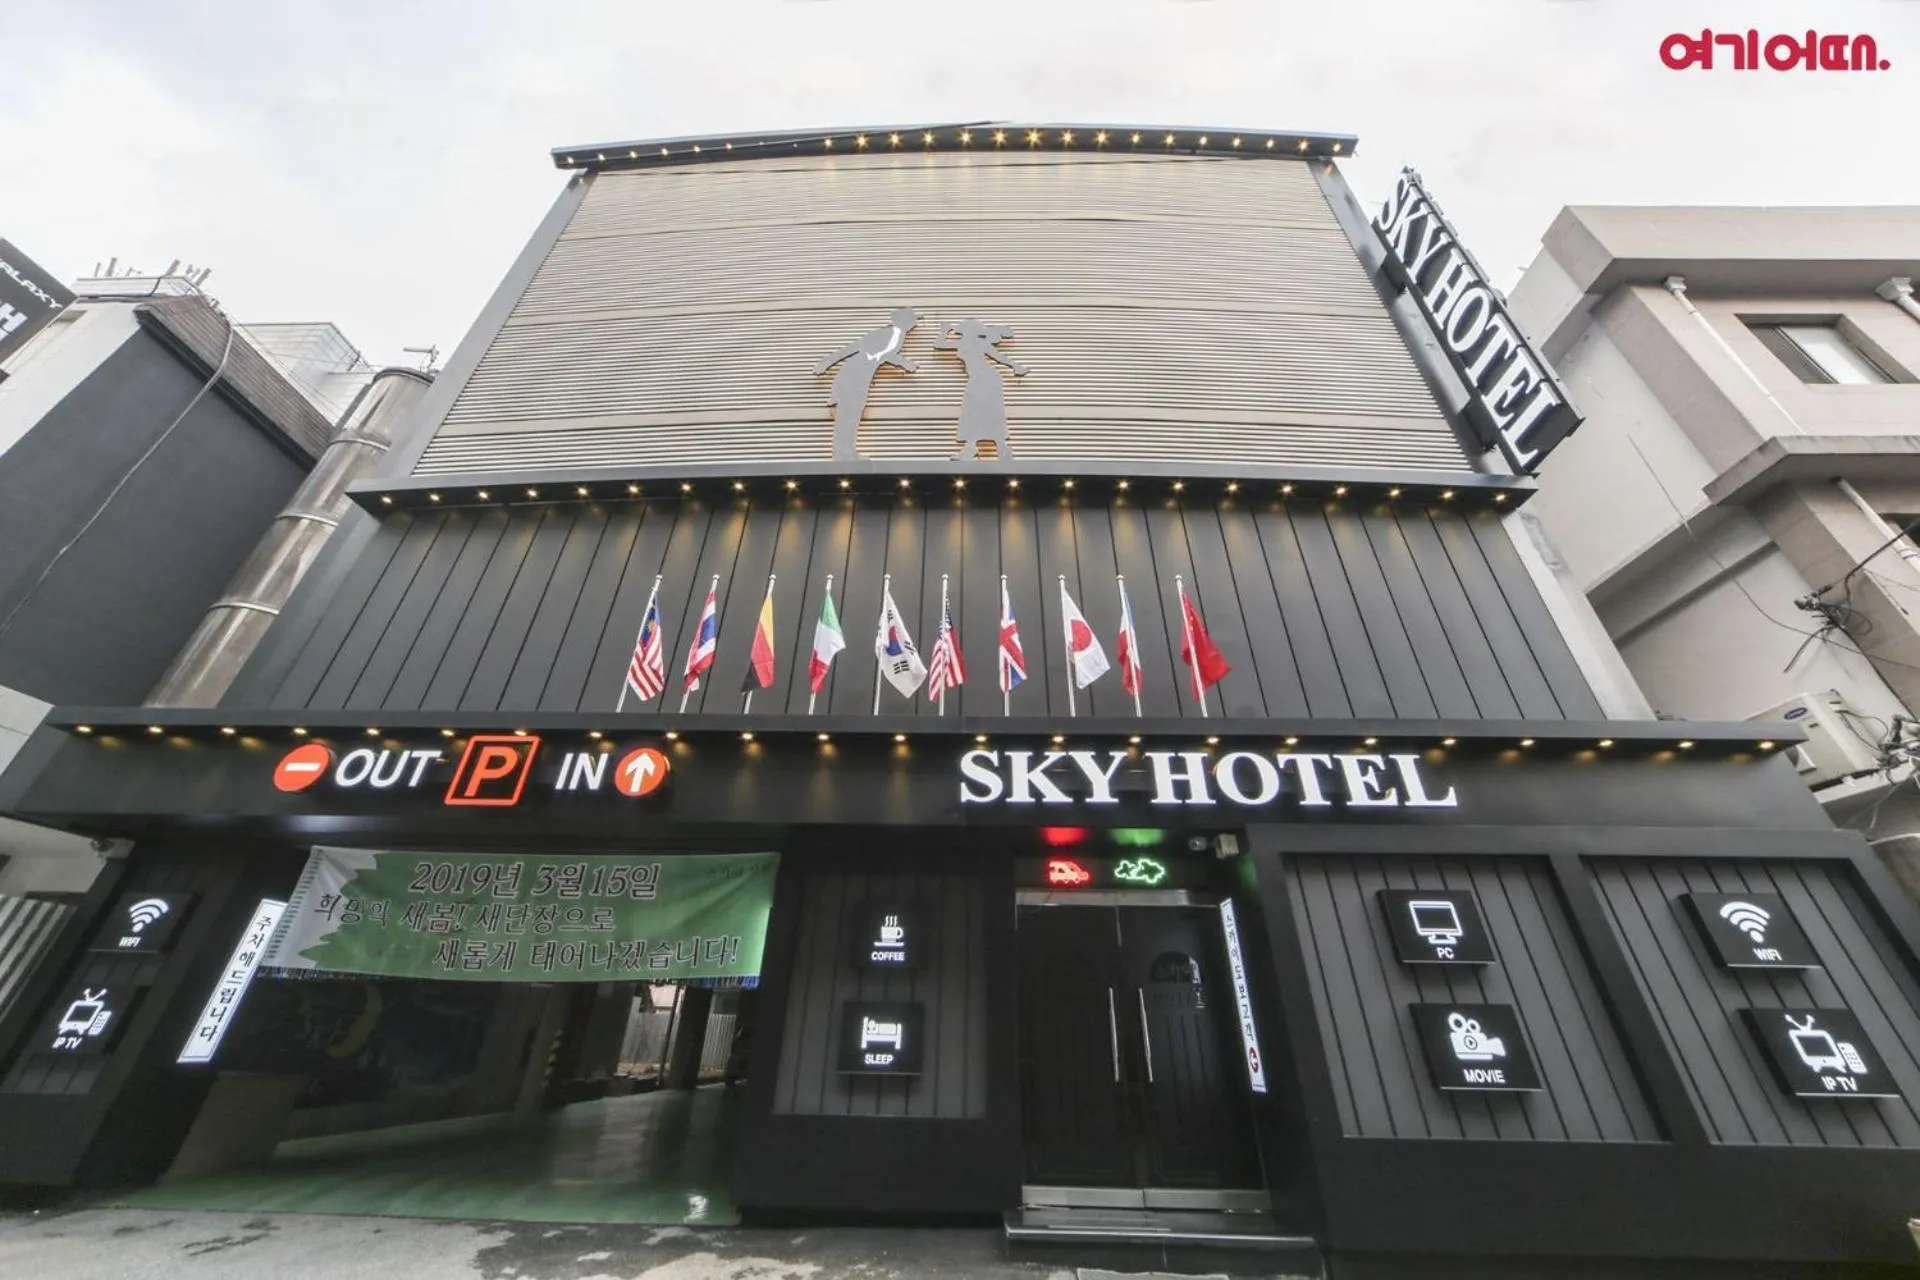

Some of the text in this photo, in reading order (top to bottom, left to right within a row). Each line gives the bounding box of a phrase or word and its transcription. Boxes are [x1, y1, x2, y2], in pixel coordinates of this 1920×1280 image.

[1376, 173, 1559, 468] SKY HOTEL
[334, 746, 609, 797] OUT P IN
[960, 749, 1458, 807] SKY HOTEL
[408, 862, 661, 898] 2019년 3월 15일
[399, 901, 469, 932] 새봄!
[476, 903, 616, 934] 새단장으로
[434, 936, 742, 972] 새롭게 태어나겠습니다!
[871, 951, 905, 962] COFFEE
[1436, 947, 1455, 960] PC
[1753, 948, 1783, 961] WIFI
[864, 1054, 894, 1065] SLEEP
[1463, 1068, 1506, 1084] MOVIE
